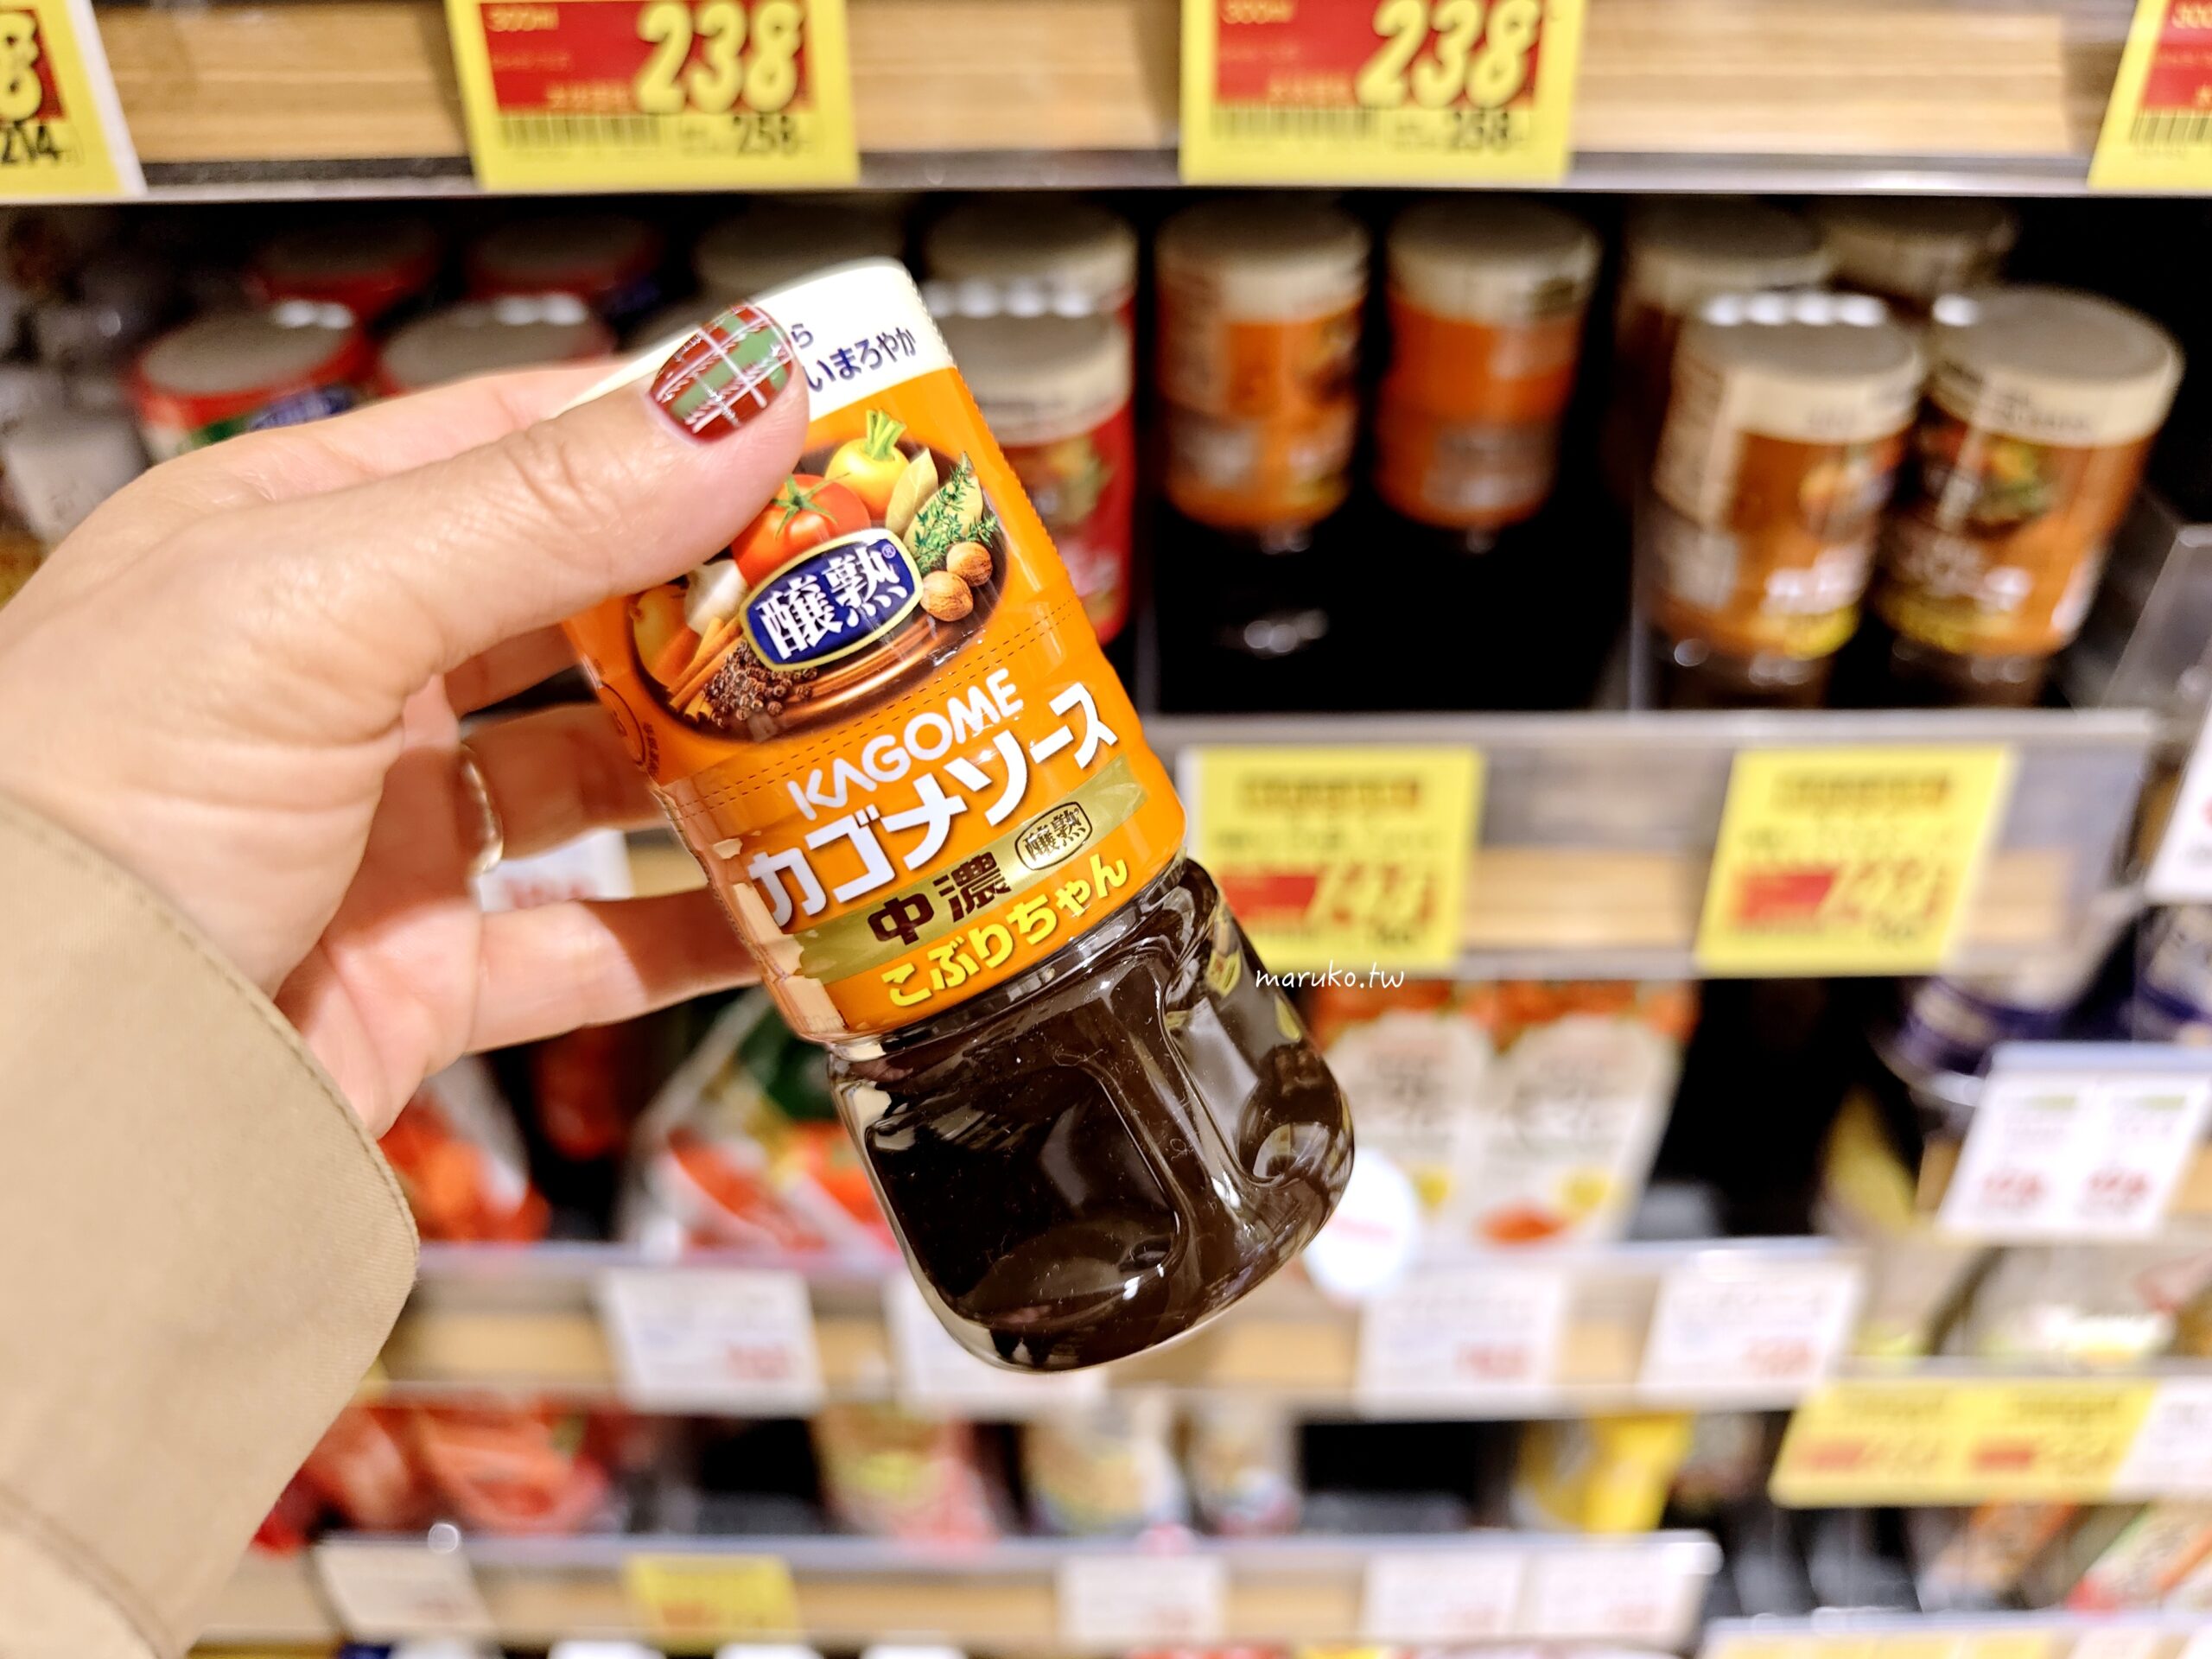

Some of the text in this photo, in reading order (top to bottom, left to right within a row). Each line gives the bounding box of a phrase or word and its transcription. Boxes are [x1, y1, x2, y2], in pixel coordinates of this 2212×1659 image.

[635, 2, 805, 115] 238
[1355, 0, 1544, 109] 238
[802, 327, 916, 392] いまろやか
[787, 668, 1024, 820] KAGOME
[748, 682, 1119, 927] カゴメソース
[868, 850, 1012, 945] 中濃
[880, 854, 1128, 1007] こぶりちゃん
